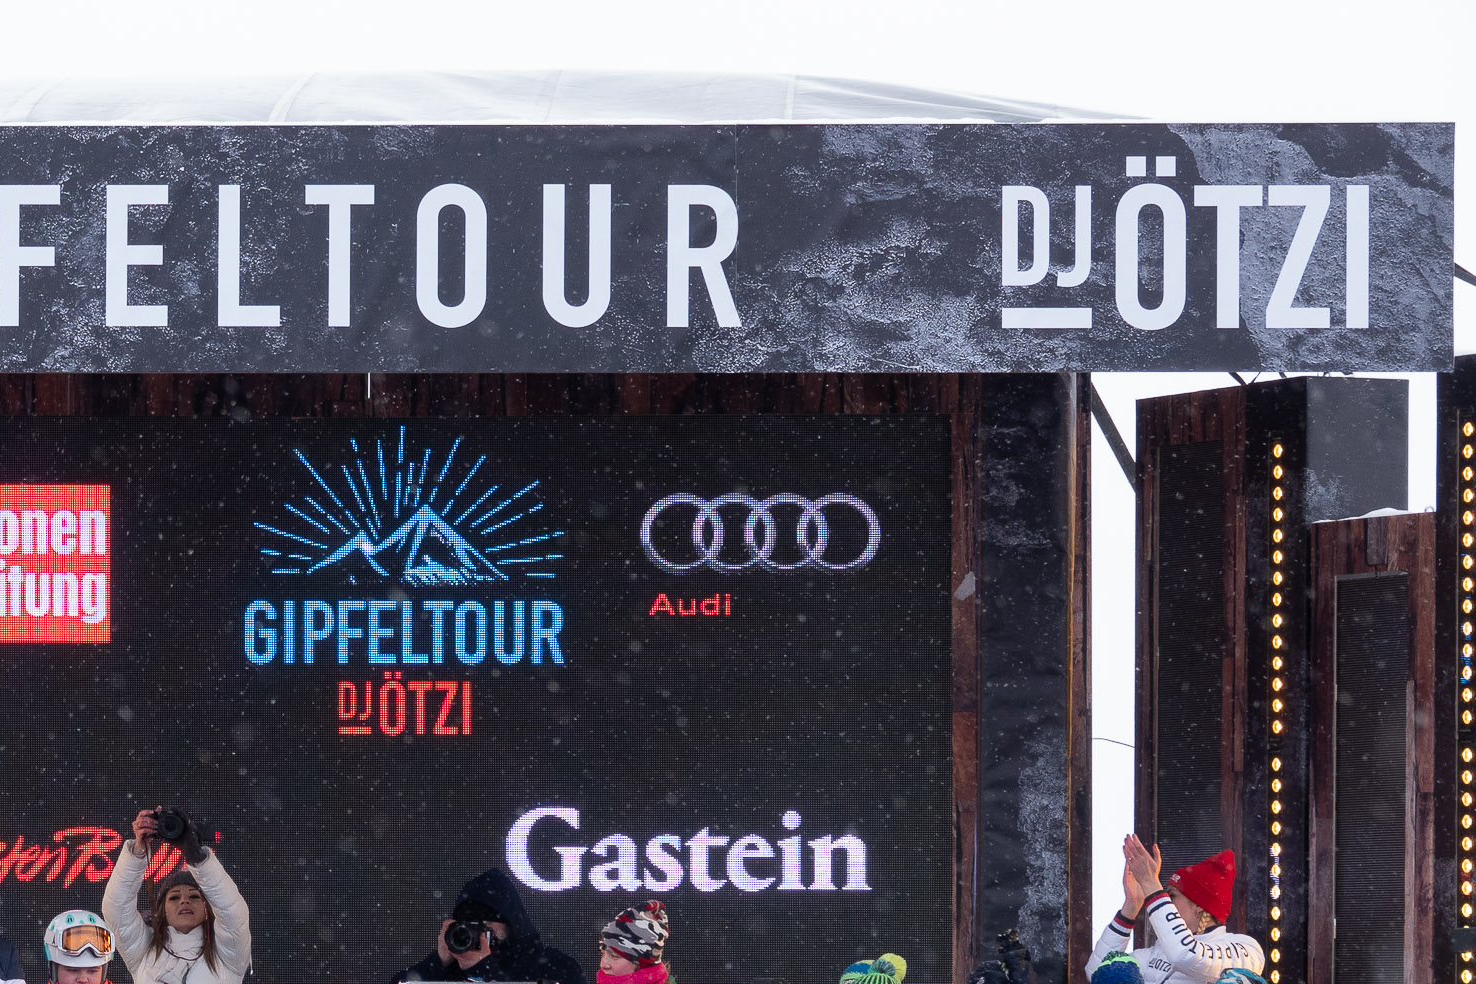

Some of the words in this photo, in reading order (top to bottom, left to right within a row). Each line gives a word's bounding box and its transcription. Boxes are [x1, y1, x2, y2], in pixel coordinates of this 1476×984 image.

[244, 599, 566, 665] GIPFELTOUR
[649, 593, 731, 616] Audi
[505, 807, 873, 893] Gastein
